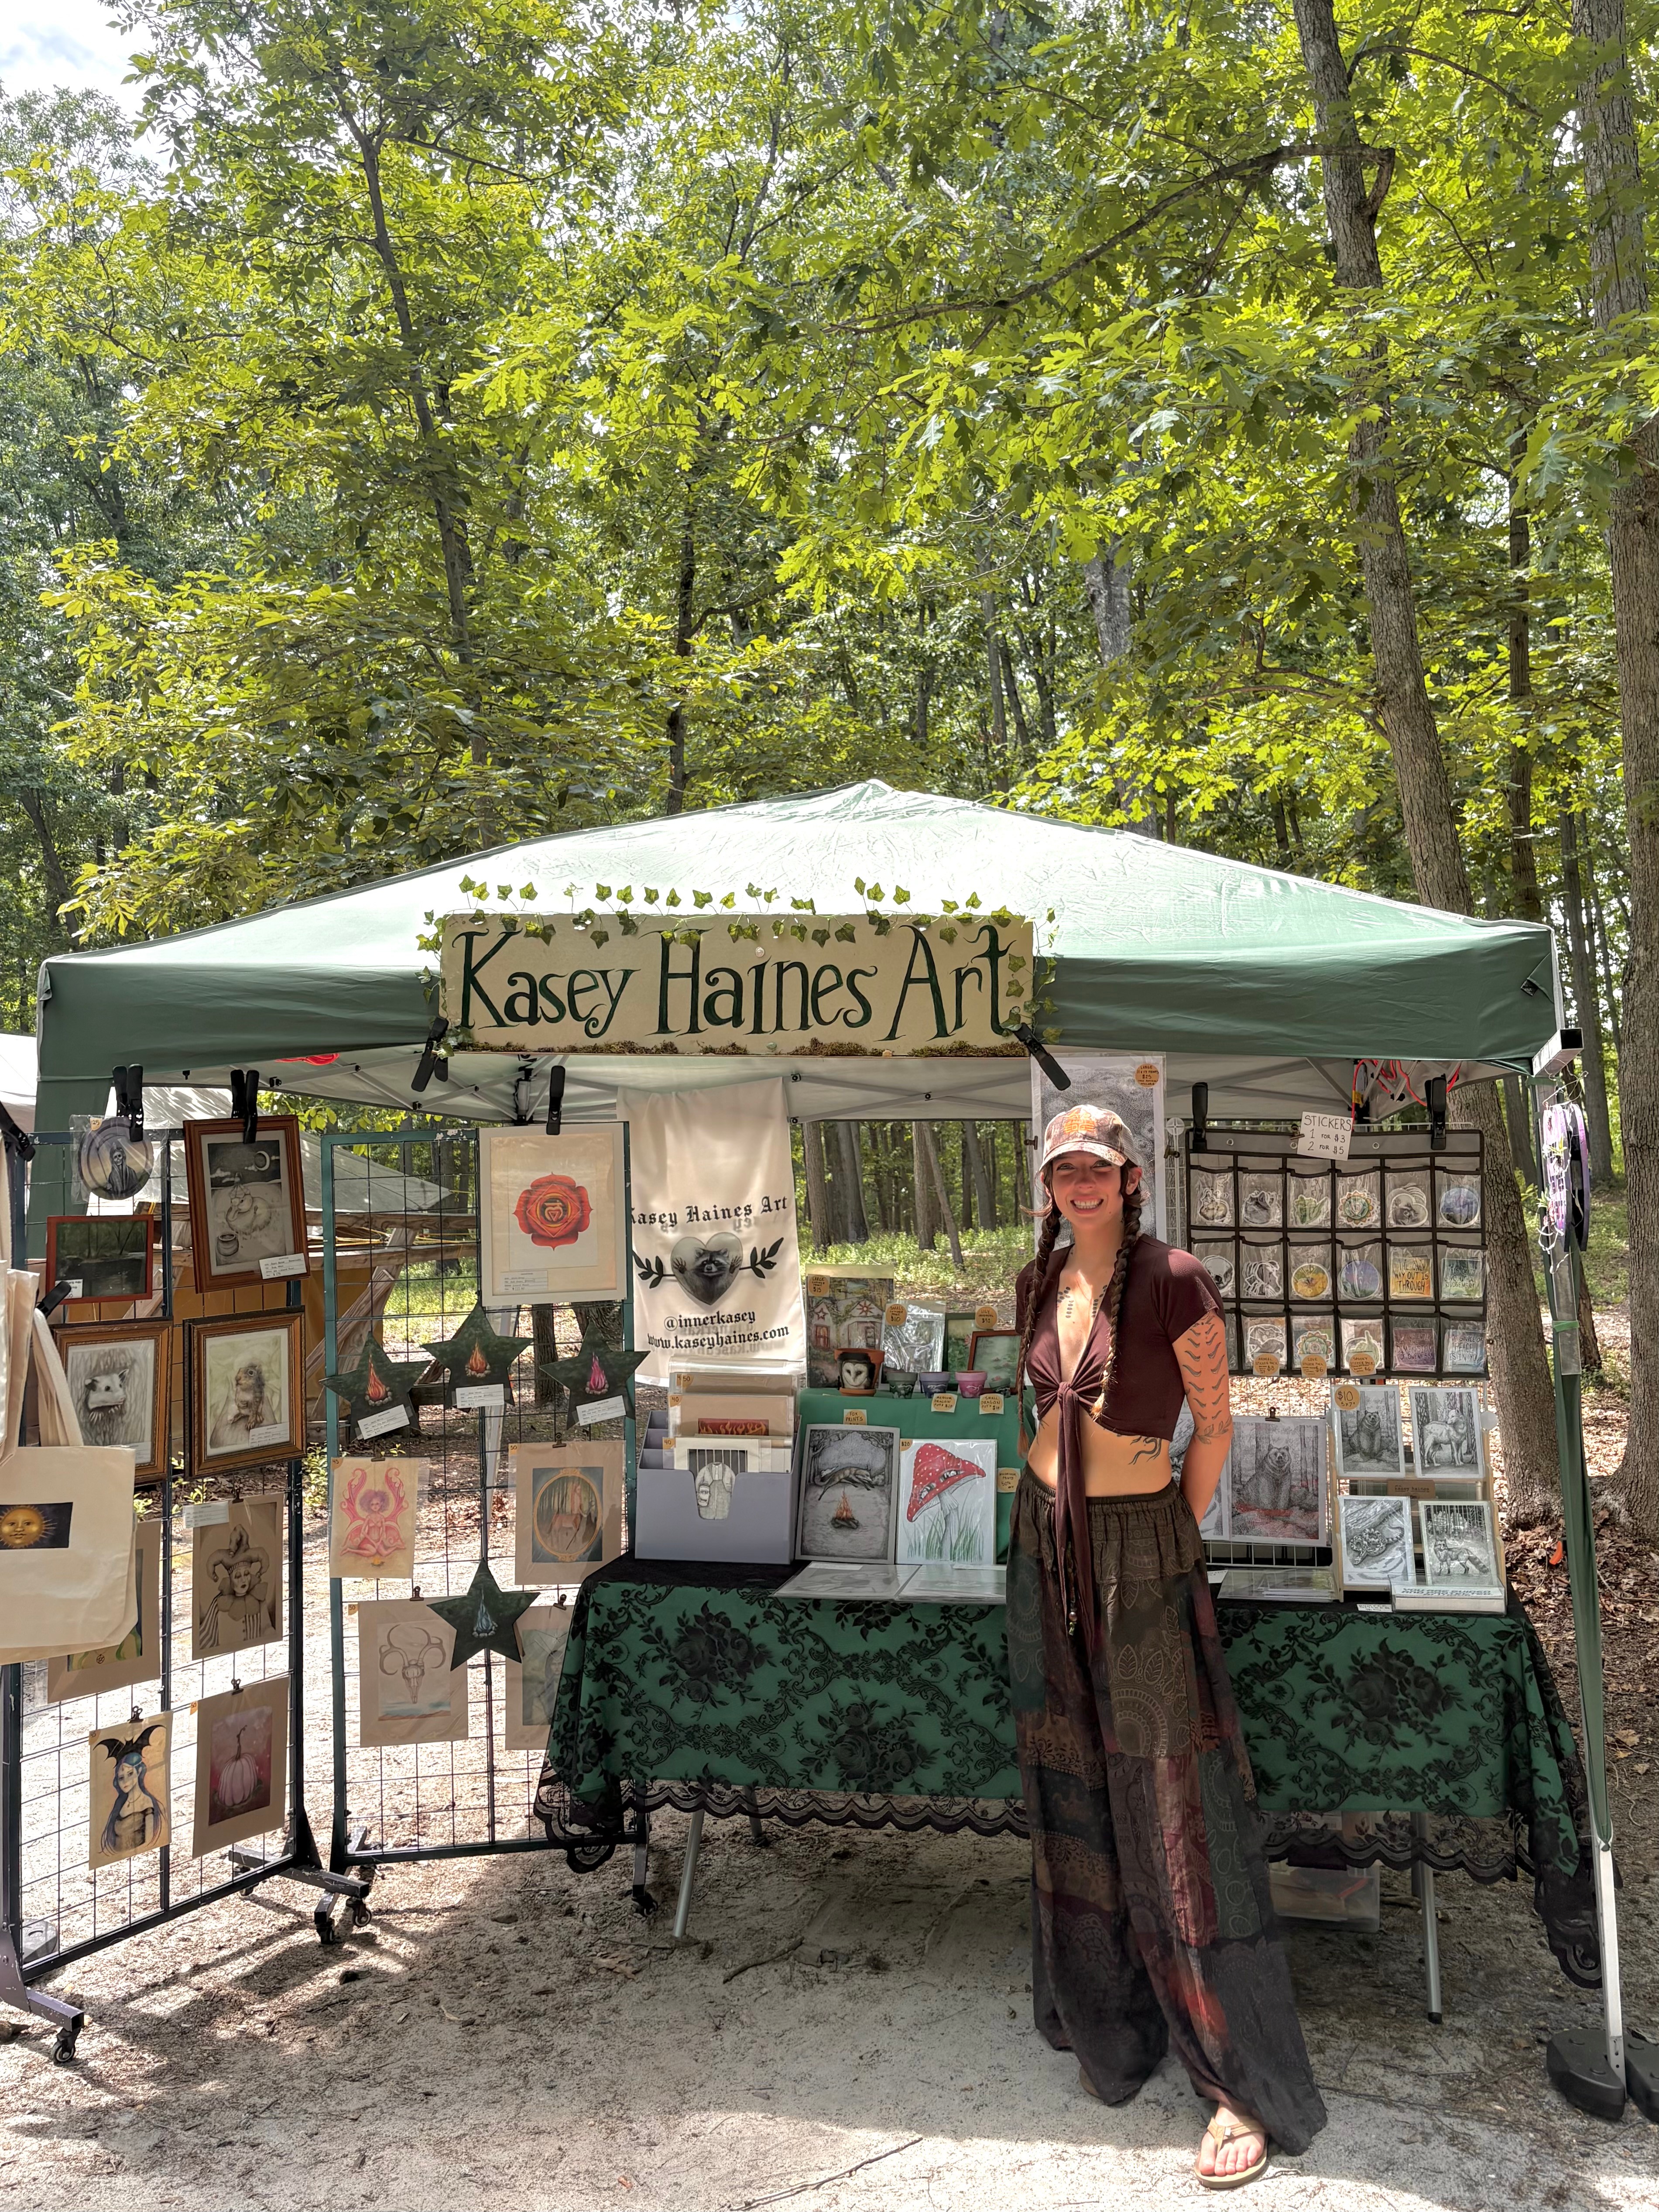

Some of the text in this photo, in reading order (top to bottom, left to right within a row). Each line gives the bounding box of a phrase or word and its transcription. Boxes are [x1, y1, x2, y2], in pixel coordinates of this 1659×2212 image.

[453, 924, 1021, 1042] Kasey Haines Art
[1304, 1115, 1352, 1132] STICKERS
[1310, 1128, 1315, 1139] 1
[1308, 1141, 1314, 1151] 2
[686, 1204, 753, 1223] Haines
[761, 1196, 788, 1214] Art
[1398, 1259, 1426, 1271] THE ONLY
[1393, 1270, 1405, 1279] WAY
[1422, 1272, 1429, 1280] IS
[1397, 1280, 1425, 1292] THROUGH
[664, 1310, 756, 1331] @innerkasey
[648, 1326, 789, 1349] www.kaseyhaines.com
[1396, 1345, 1432, 1353] DIMENSION
[1455, 1343, 1473, 1353] PEACE
[1458, 1354, 1467, 1362] IN
[1337, 1390, 1354, 1401] $10
